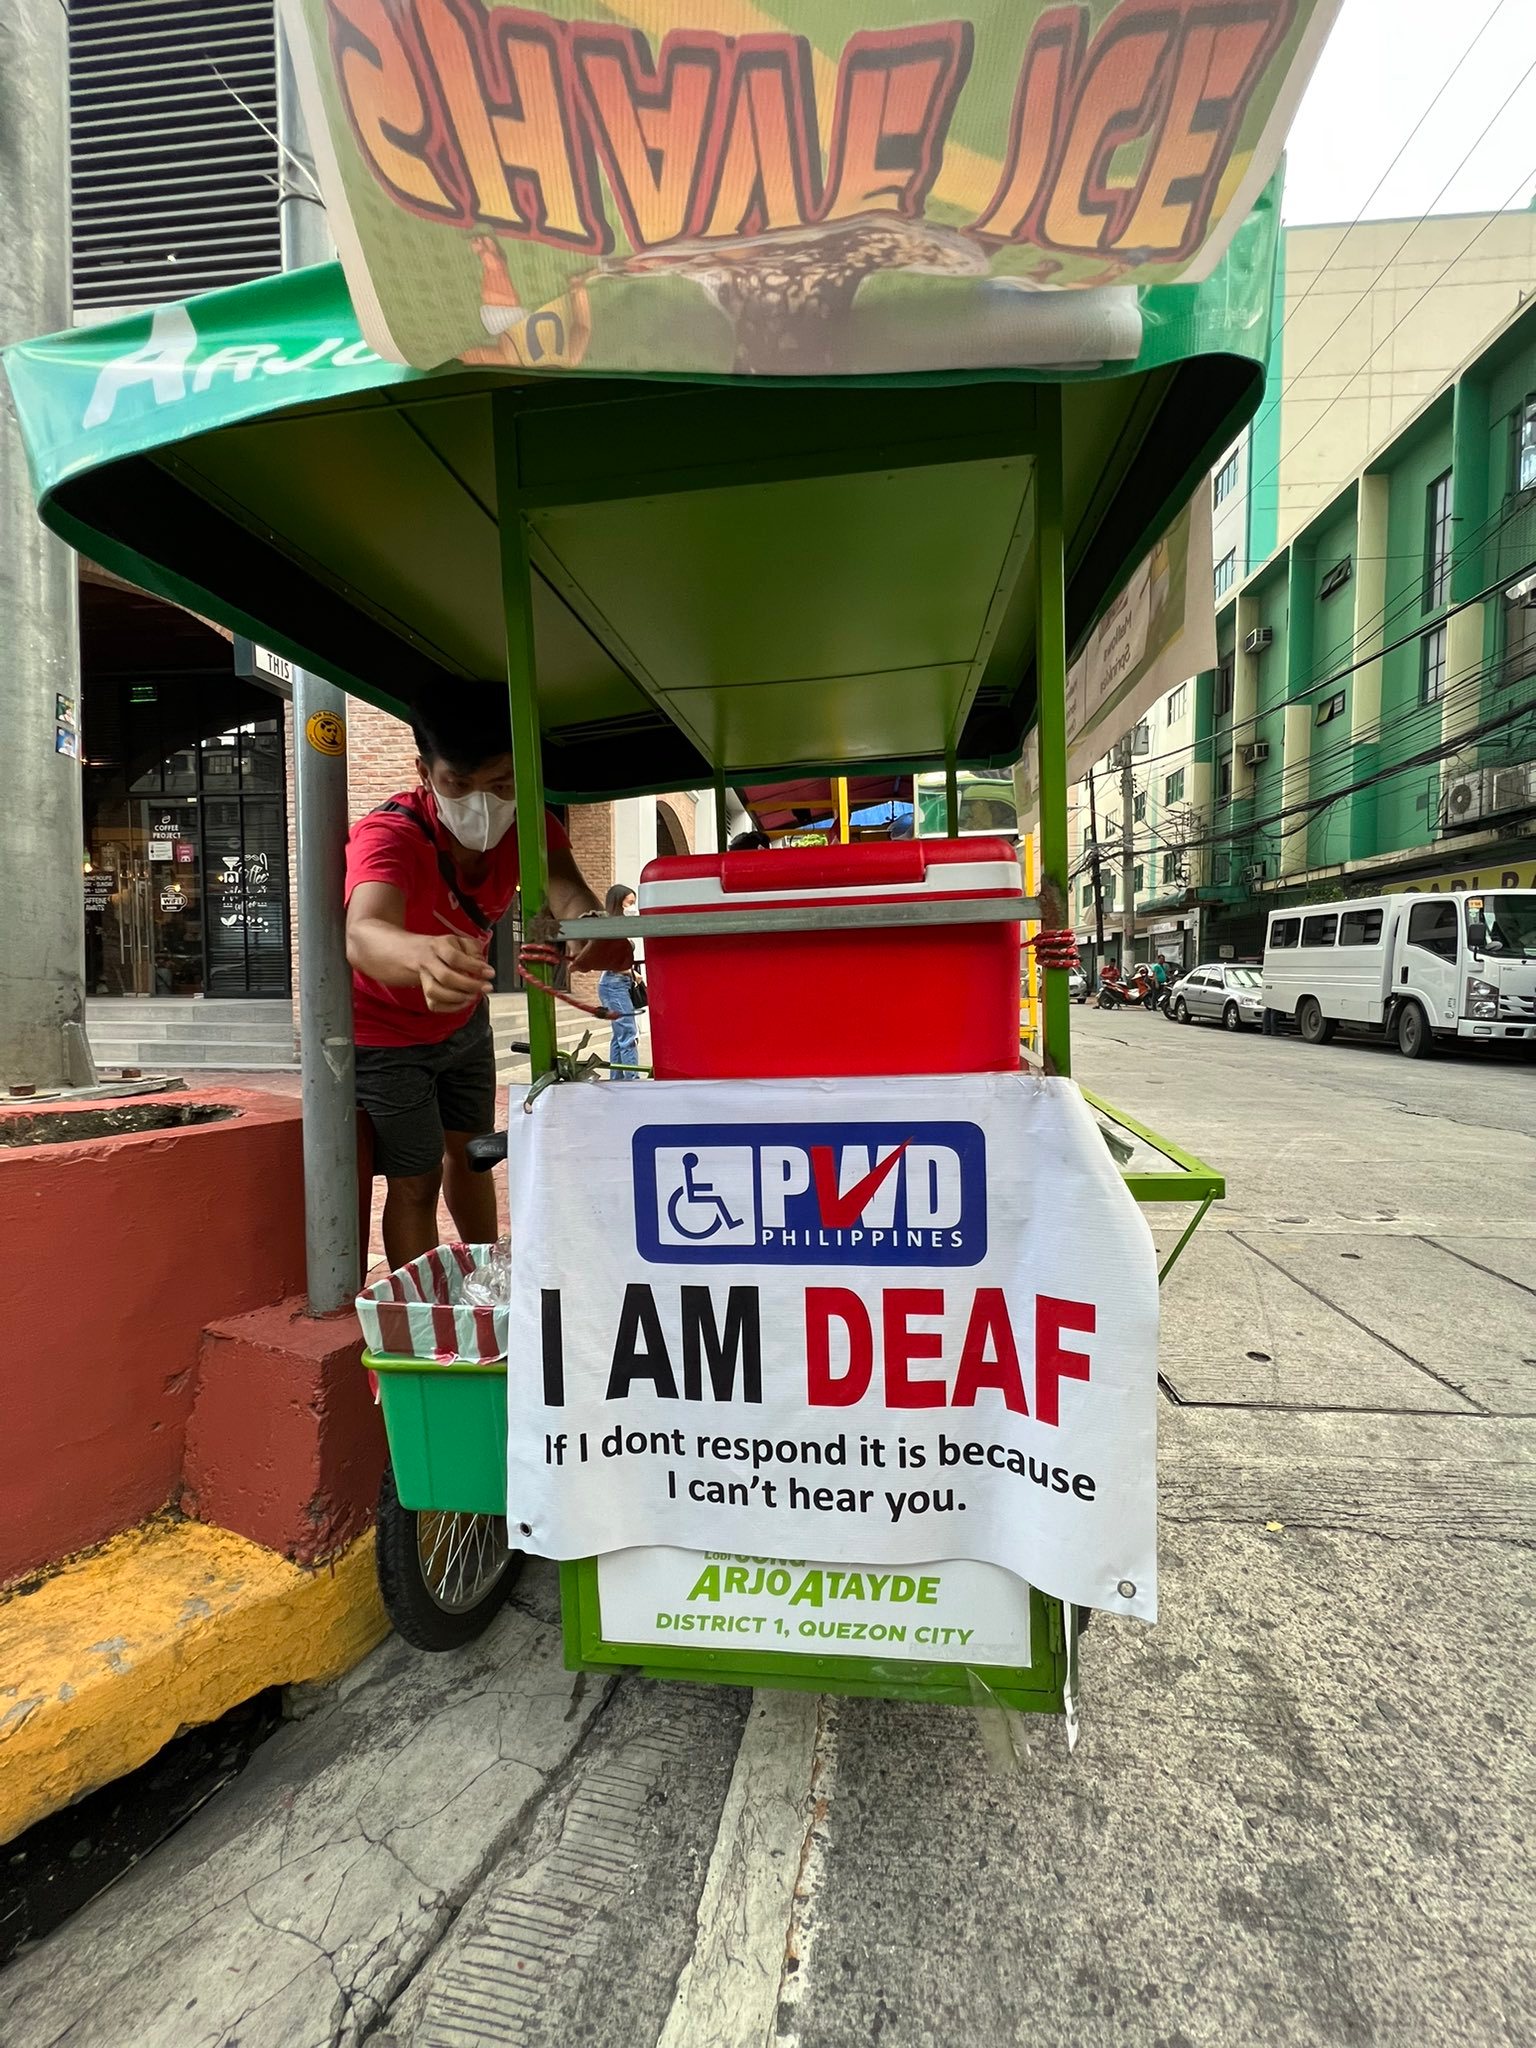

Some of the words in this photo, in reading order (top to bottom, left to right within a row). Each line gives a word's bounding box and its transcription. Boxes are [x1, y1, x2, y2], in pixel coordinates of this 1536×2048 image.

[267, 653, 290, 679] THIS
[152, 832, 181, 840] PROJECT
[154, 824, 179, 832] COFFEE
[759, 1138, 962, 1230] PWD
[762, 1229, 964, 1248] PHILIPPINES
[540, 1288, 565, 1407] I
[606, 1283, 763, 1404] AM
[805, 1287, 1096, 1427] DEAF
[545, 1433, 568, 1466] If
[579, 1432, 588, 1463] I
[601, 1424, 686, 1458] dont
[697, 1433, 846, 1470] respond
[859, 1435, 886, 1468] it
[898, 1437, 926, 1469] is
[934, 1433, 1096, 1505] because
[668, 1470, 676, 1500] I
[688, 1474, 777, 1508] can’t
[789, 1480, 874, 1514] hear
[884, 1487, 967, 1523] you.
[687, 1564, 792, 1602] ARJO
[788, 1570, 941, 1608] ATAYDE
[655, 1612, 767, 1635] DISTRICT
[774, 1618, 790, 1638] 1,
[799, 1620, 907, 1642] QUEZON
[914, 1626, 975, 1647] CITY
